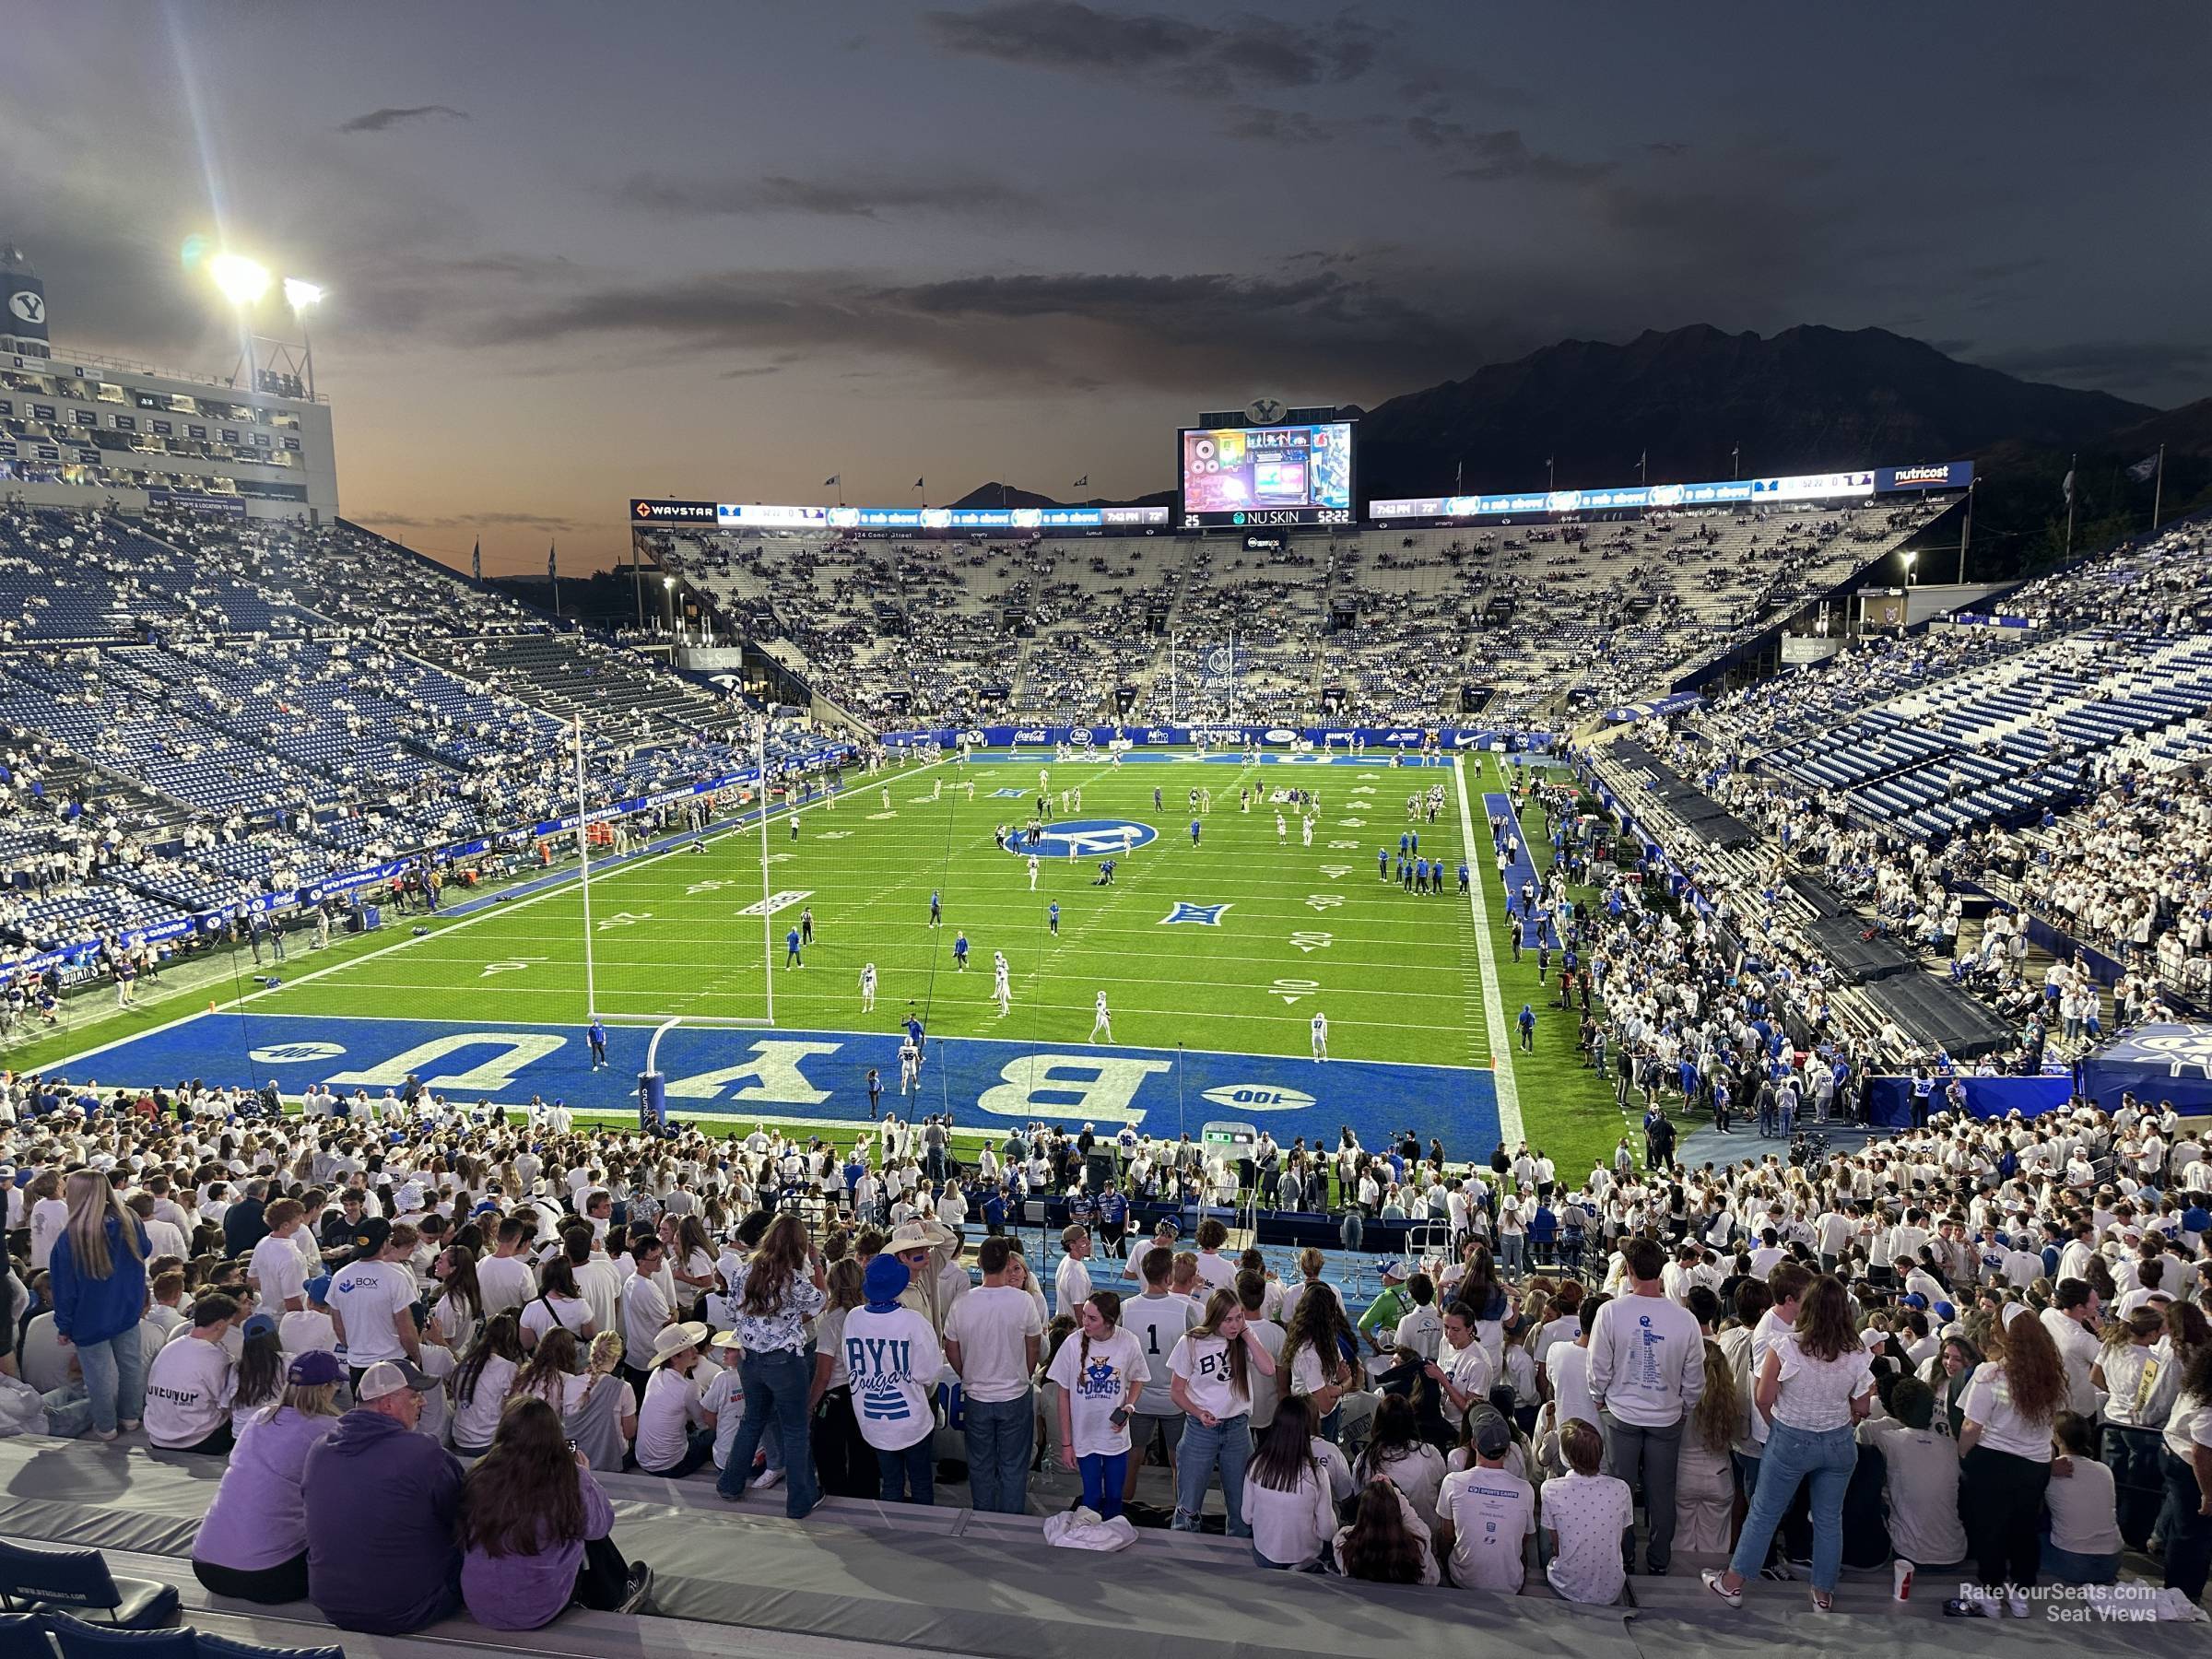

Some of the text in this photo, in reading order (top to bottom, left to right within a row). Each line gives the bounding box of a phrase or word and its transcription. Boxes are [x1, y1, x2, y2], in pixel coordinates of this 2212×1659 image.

[1252, 399, 1279, 421] Y
[1895, 465, 1949, 480] nutricost
[652, 506, 713, 516] WAYSTAR
[1318, 510, 1349, 523] 52:22
[1185, 515, 1199, 526] 25
[1248, 512, 1299, 524] NU SKIN
[1205, 677, 1239, 690] Allstte
[1015, 730, 1047, 742] Coca-Cola
[661, 786, 694, 804] COUGARS
[560, 806, 622, 829] BYU OOTBALL
[339, 871, 378, 887] FOOTBALL
[273, 892, 296, 905] Coca-Cola
[1305, 894, 1346, 907] 30
[1289, 931, 1334, 947] 20
[1268, 979, 1319, 994] 10
[1917, 1083, 1931, 1093] 32
[1232, 1090, 1281, 1103] 100
[1120, 1134, 1132, 1147] 96
[356, 1277, 378, 1286] BOX
[1147, 1324, 1160, 1355] 1
[846, 1337, 910, 1378] BYU
[848, 1369, 913, 1398] Cougars
